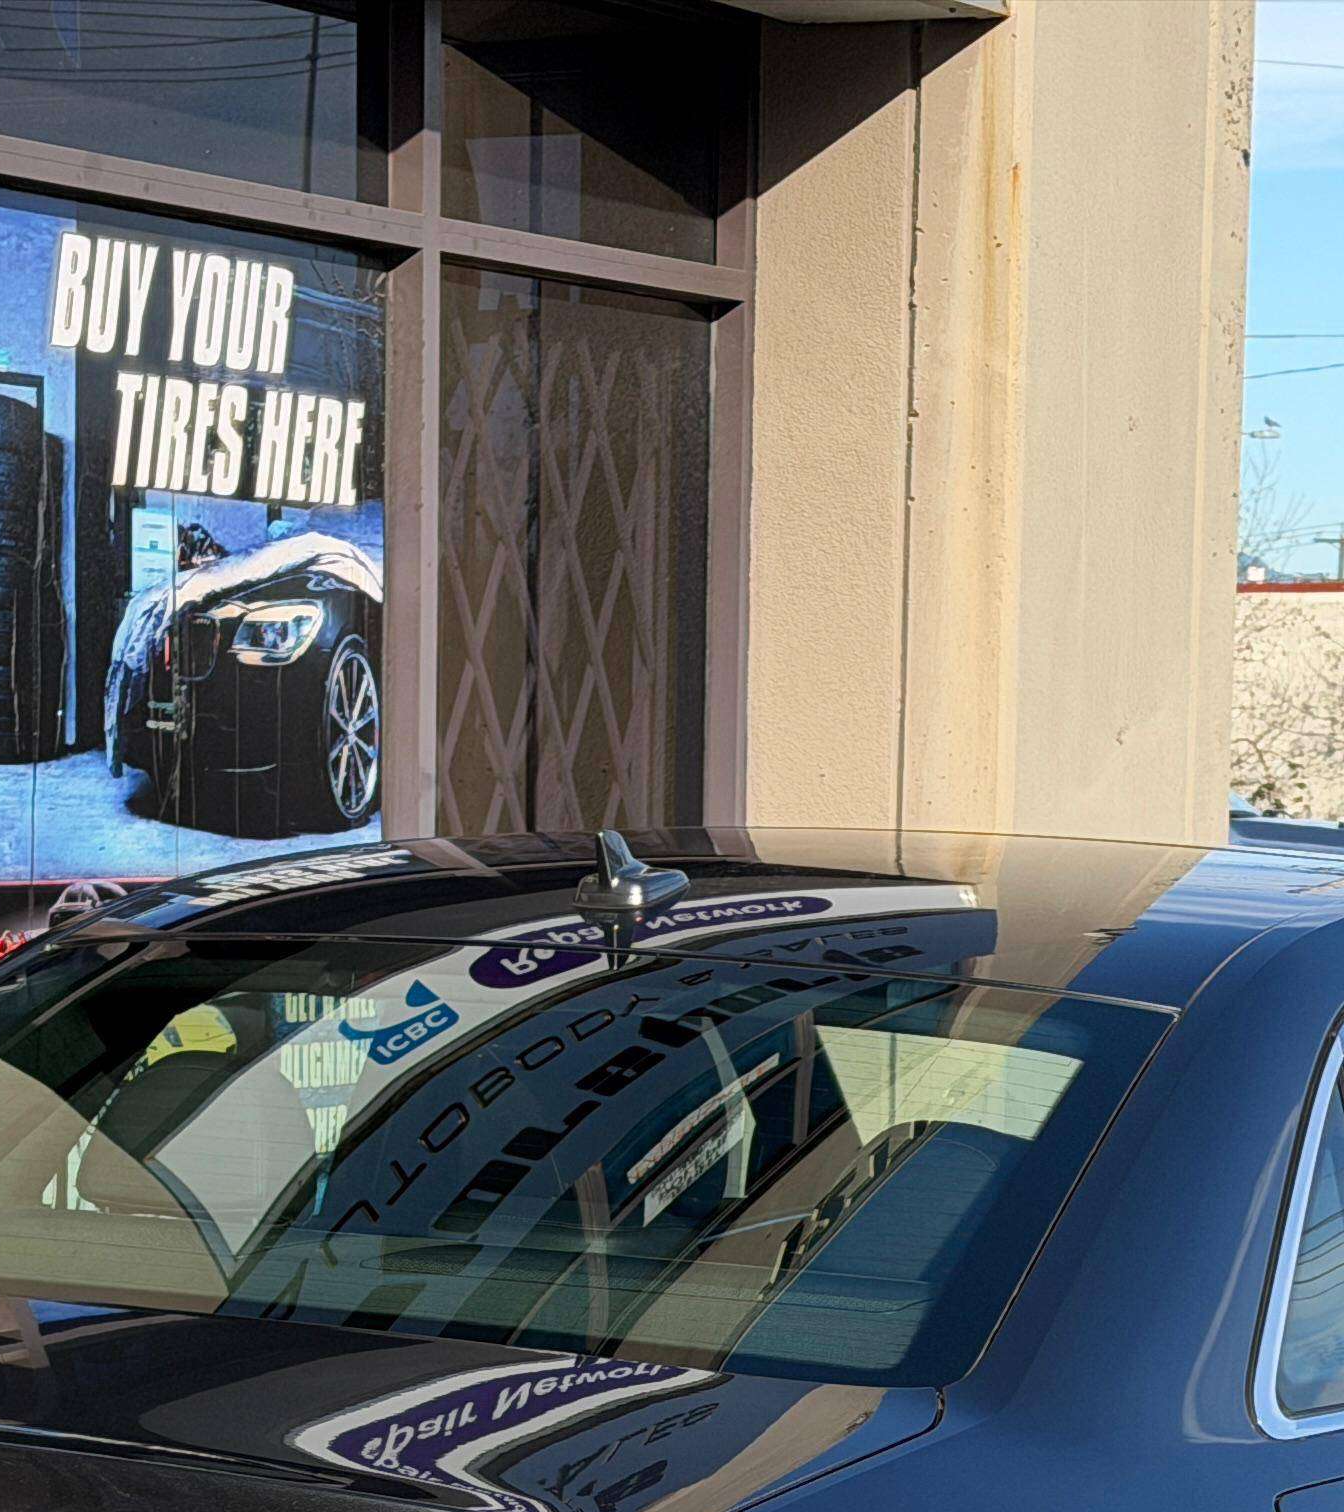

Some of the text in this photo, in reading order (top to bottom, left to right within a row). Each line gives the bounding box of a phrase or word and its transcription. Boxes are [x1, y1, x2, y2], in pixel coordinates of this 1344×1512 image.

[51, 232, 295, 374] BUY YOUR
[111, 370, 366, 506] TIRES HERE
